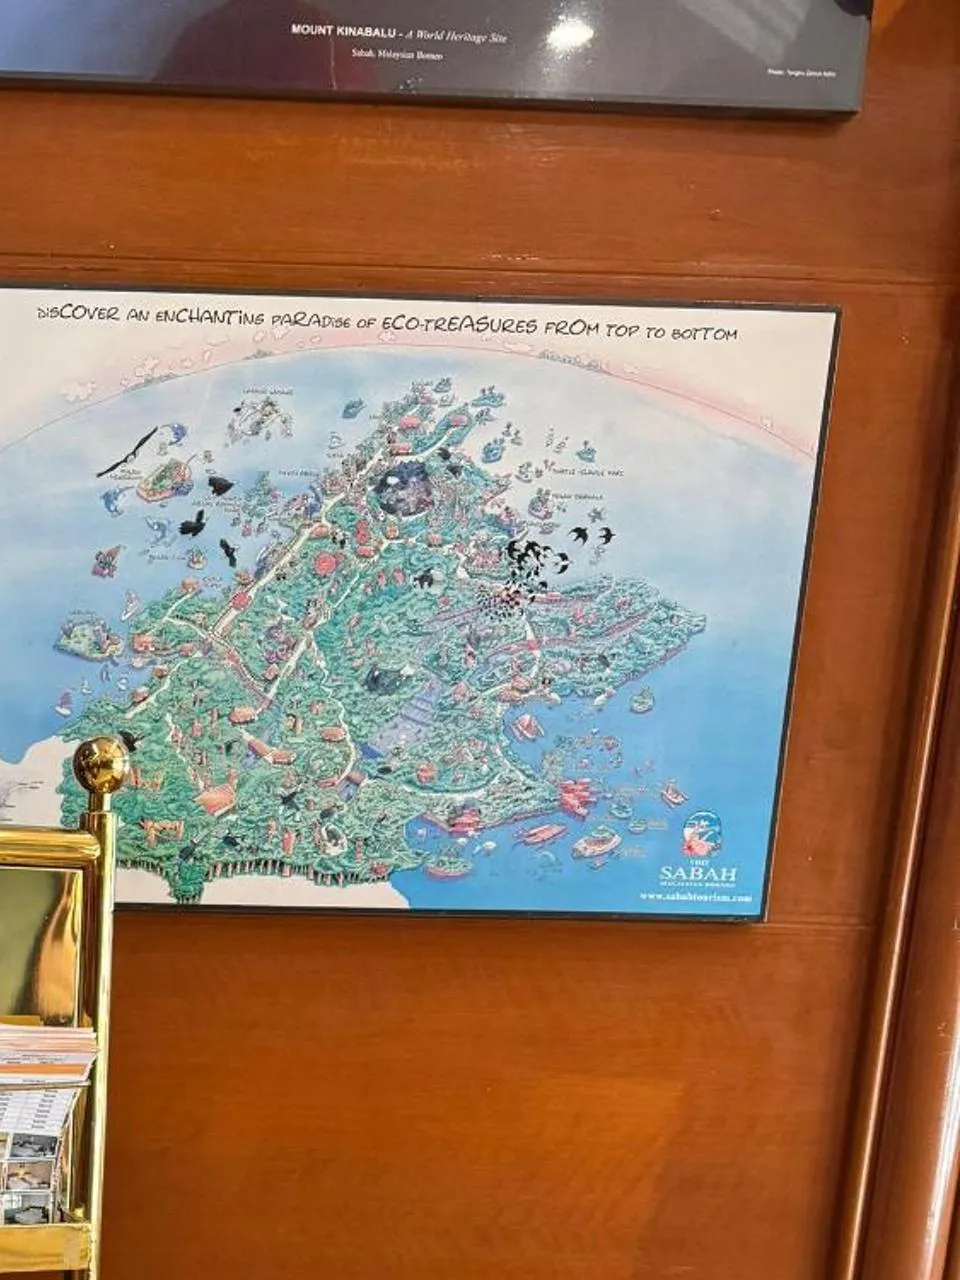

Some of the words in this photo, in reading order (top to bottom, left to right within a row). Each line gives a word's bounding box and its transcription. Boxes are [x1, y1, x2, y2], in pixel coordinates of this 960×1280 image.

[291, 24, 333, 36] MOUNT
[336, 25, 396, 38] KINABALU
[405, 30, 414, 39] A
[416, 30, 443, 41] World
[445, 30, 488, 44] Heritage
[489, 32, 508, 44] Site
[37, 303, 121, 321] DISCOVER
[126, 307, 150, 322] AN
[155, 308, 266, 325] ENCHANTING
[271, 311, 351, 329] PARADISE
[356, 316, 376, 329] OF
[382, 314, 538, 334] ECO-TREASURES
[544, 319, 600, 336] FROM
[605, 323, 642, 337] TOP
[645, 325, 666, 339] TO
[671, 326, 739, 341] BOTTOM
[660, 865, 738, 882] SABAH
